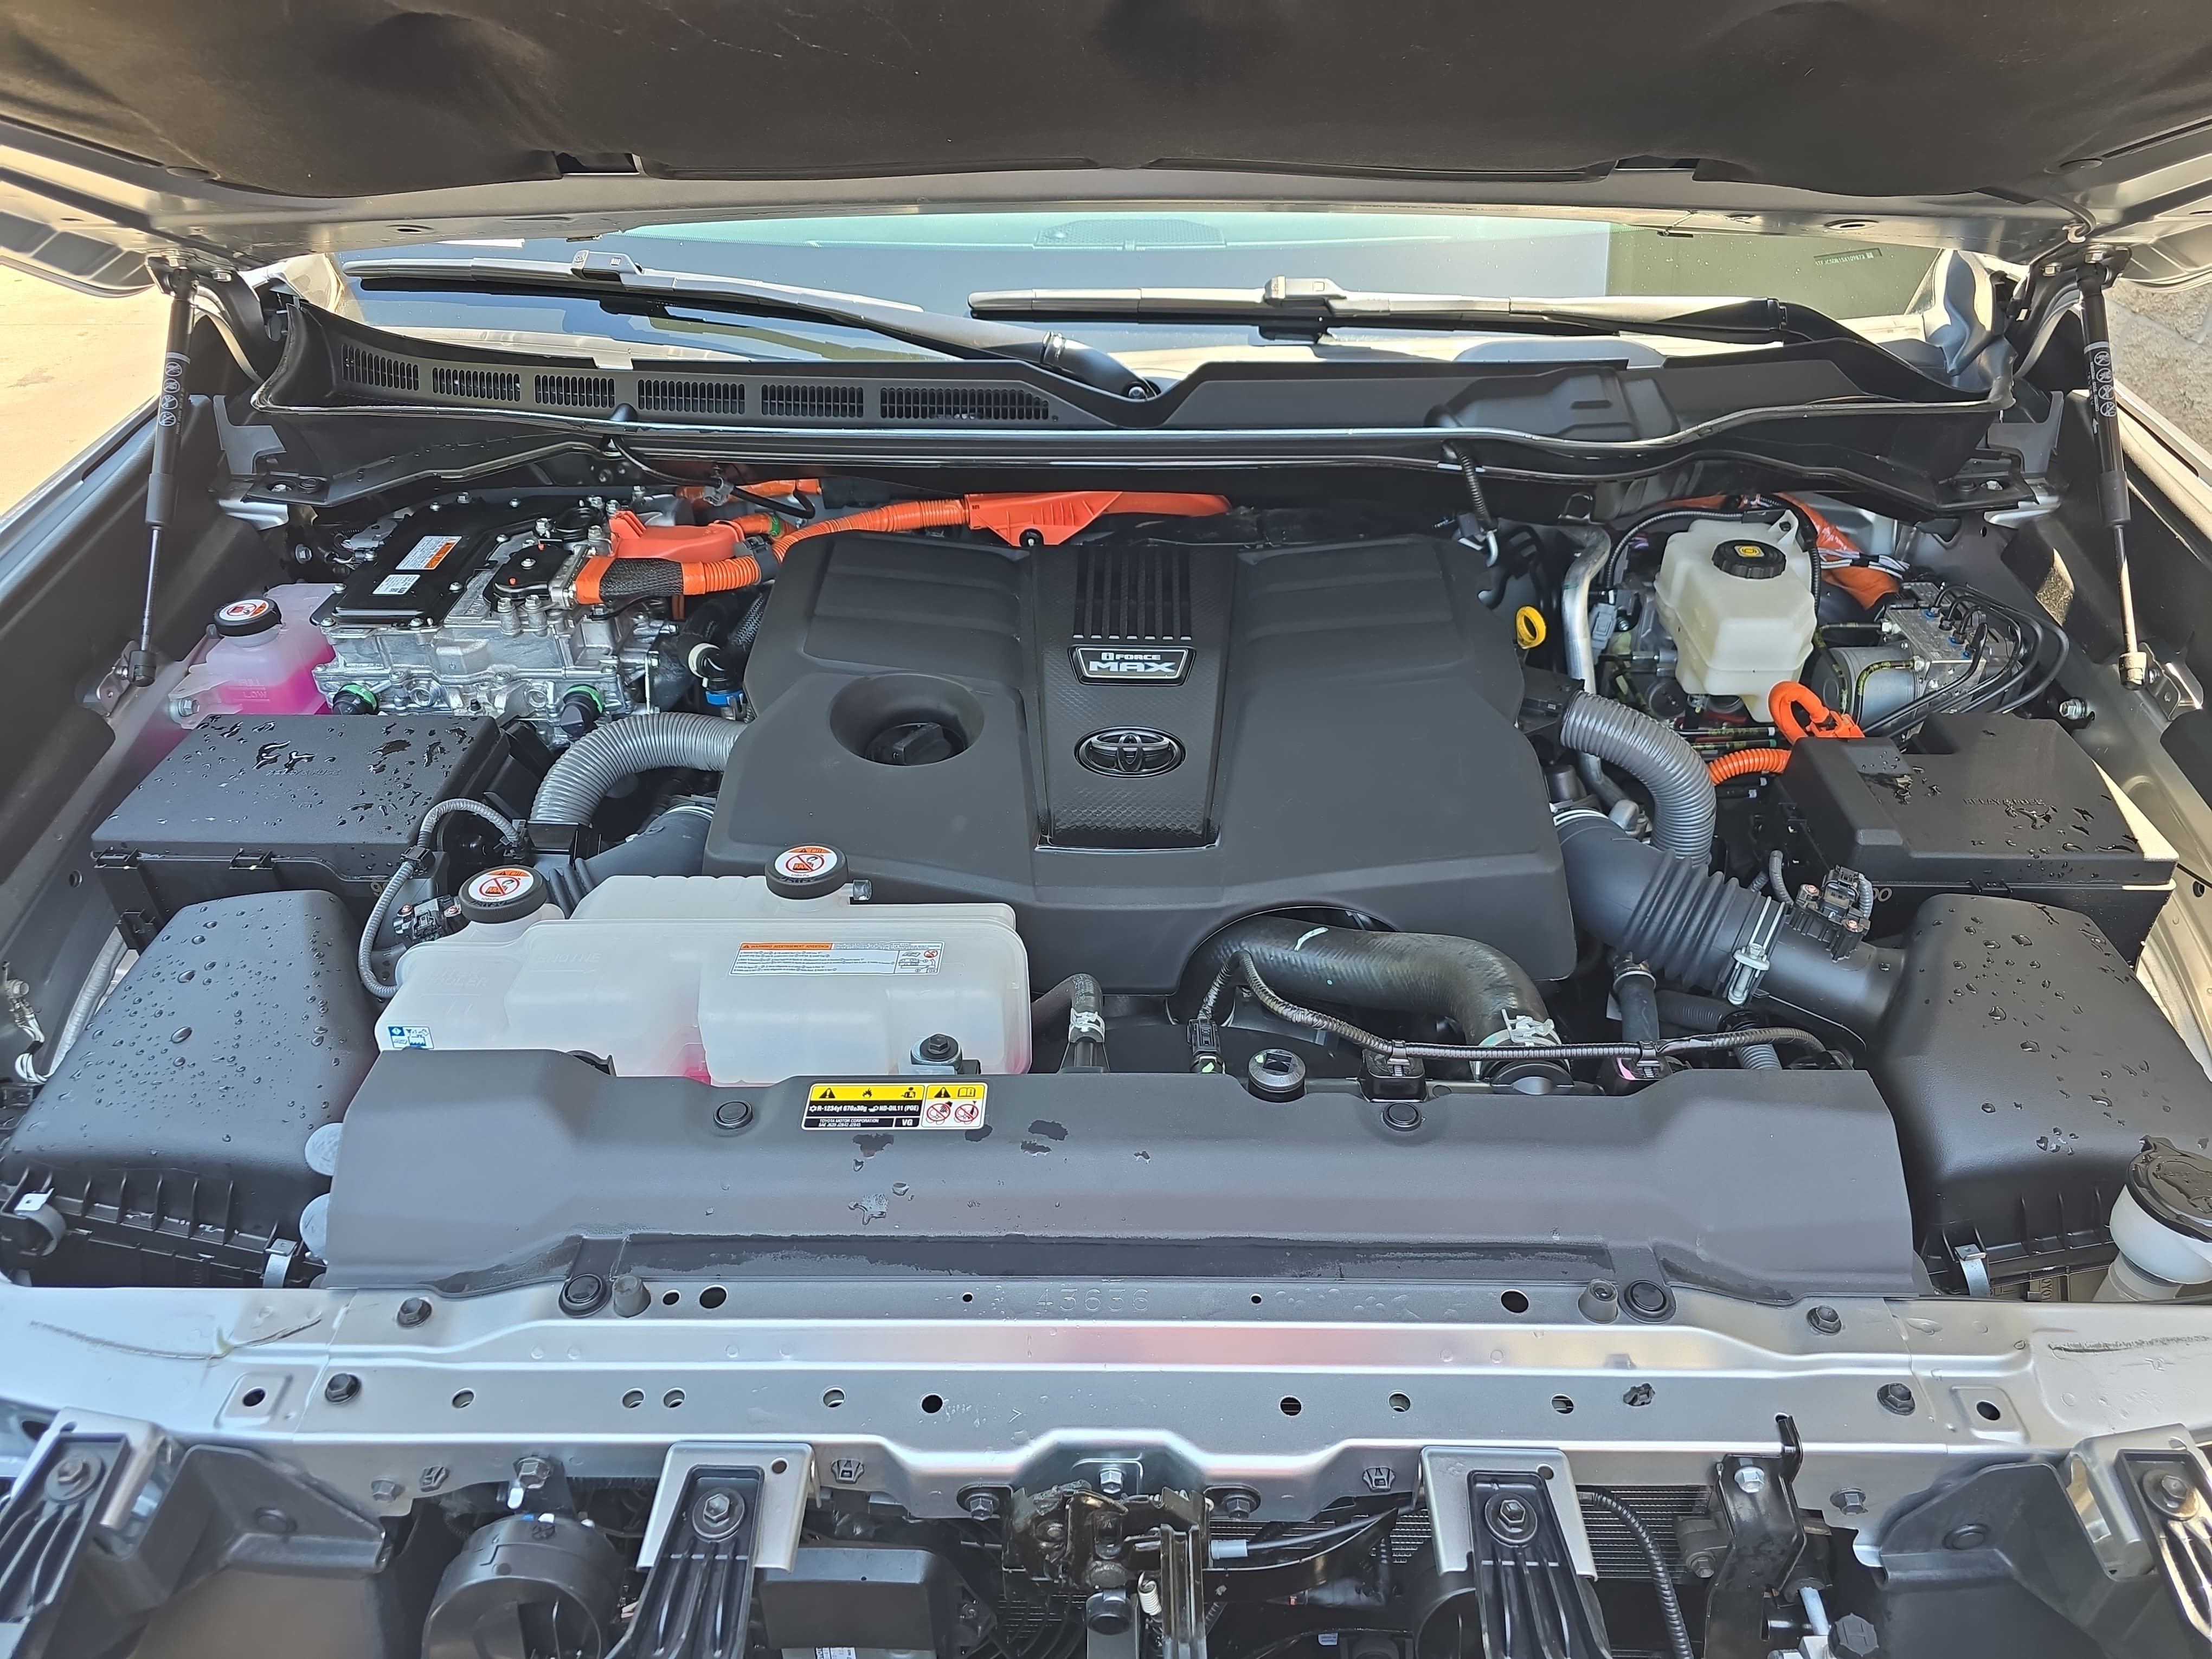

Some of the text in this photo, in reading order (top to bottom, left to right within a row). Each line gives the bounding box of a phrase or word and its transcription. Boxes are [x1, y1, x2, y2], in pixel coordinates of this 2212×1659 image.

[1089, 661, 1175, 672] MAX
[371, 882, 389, 897] 9
[1036, 1288, 1149, 1312] 43636
